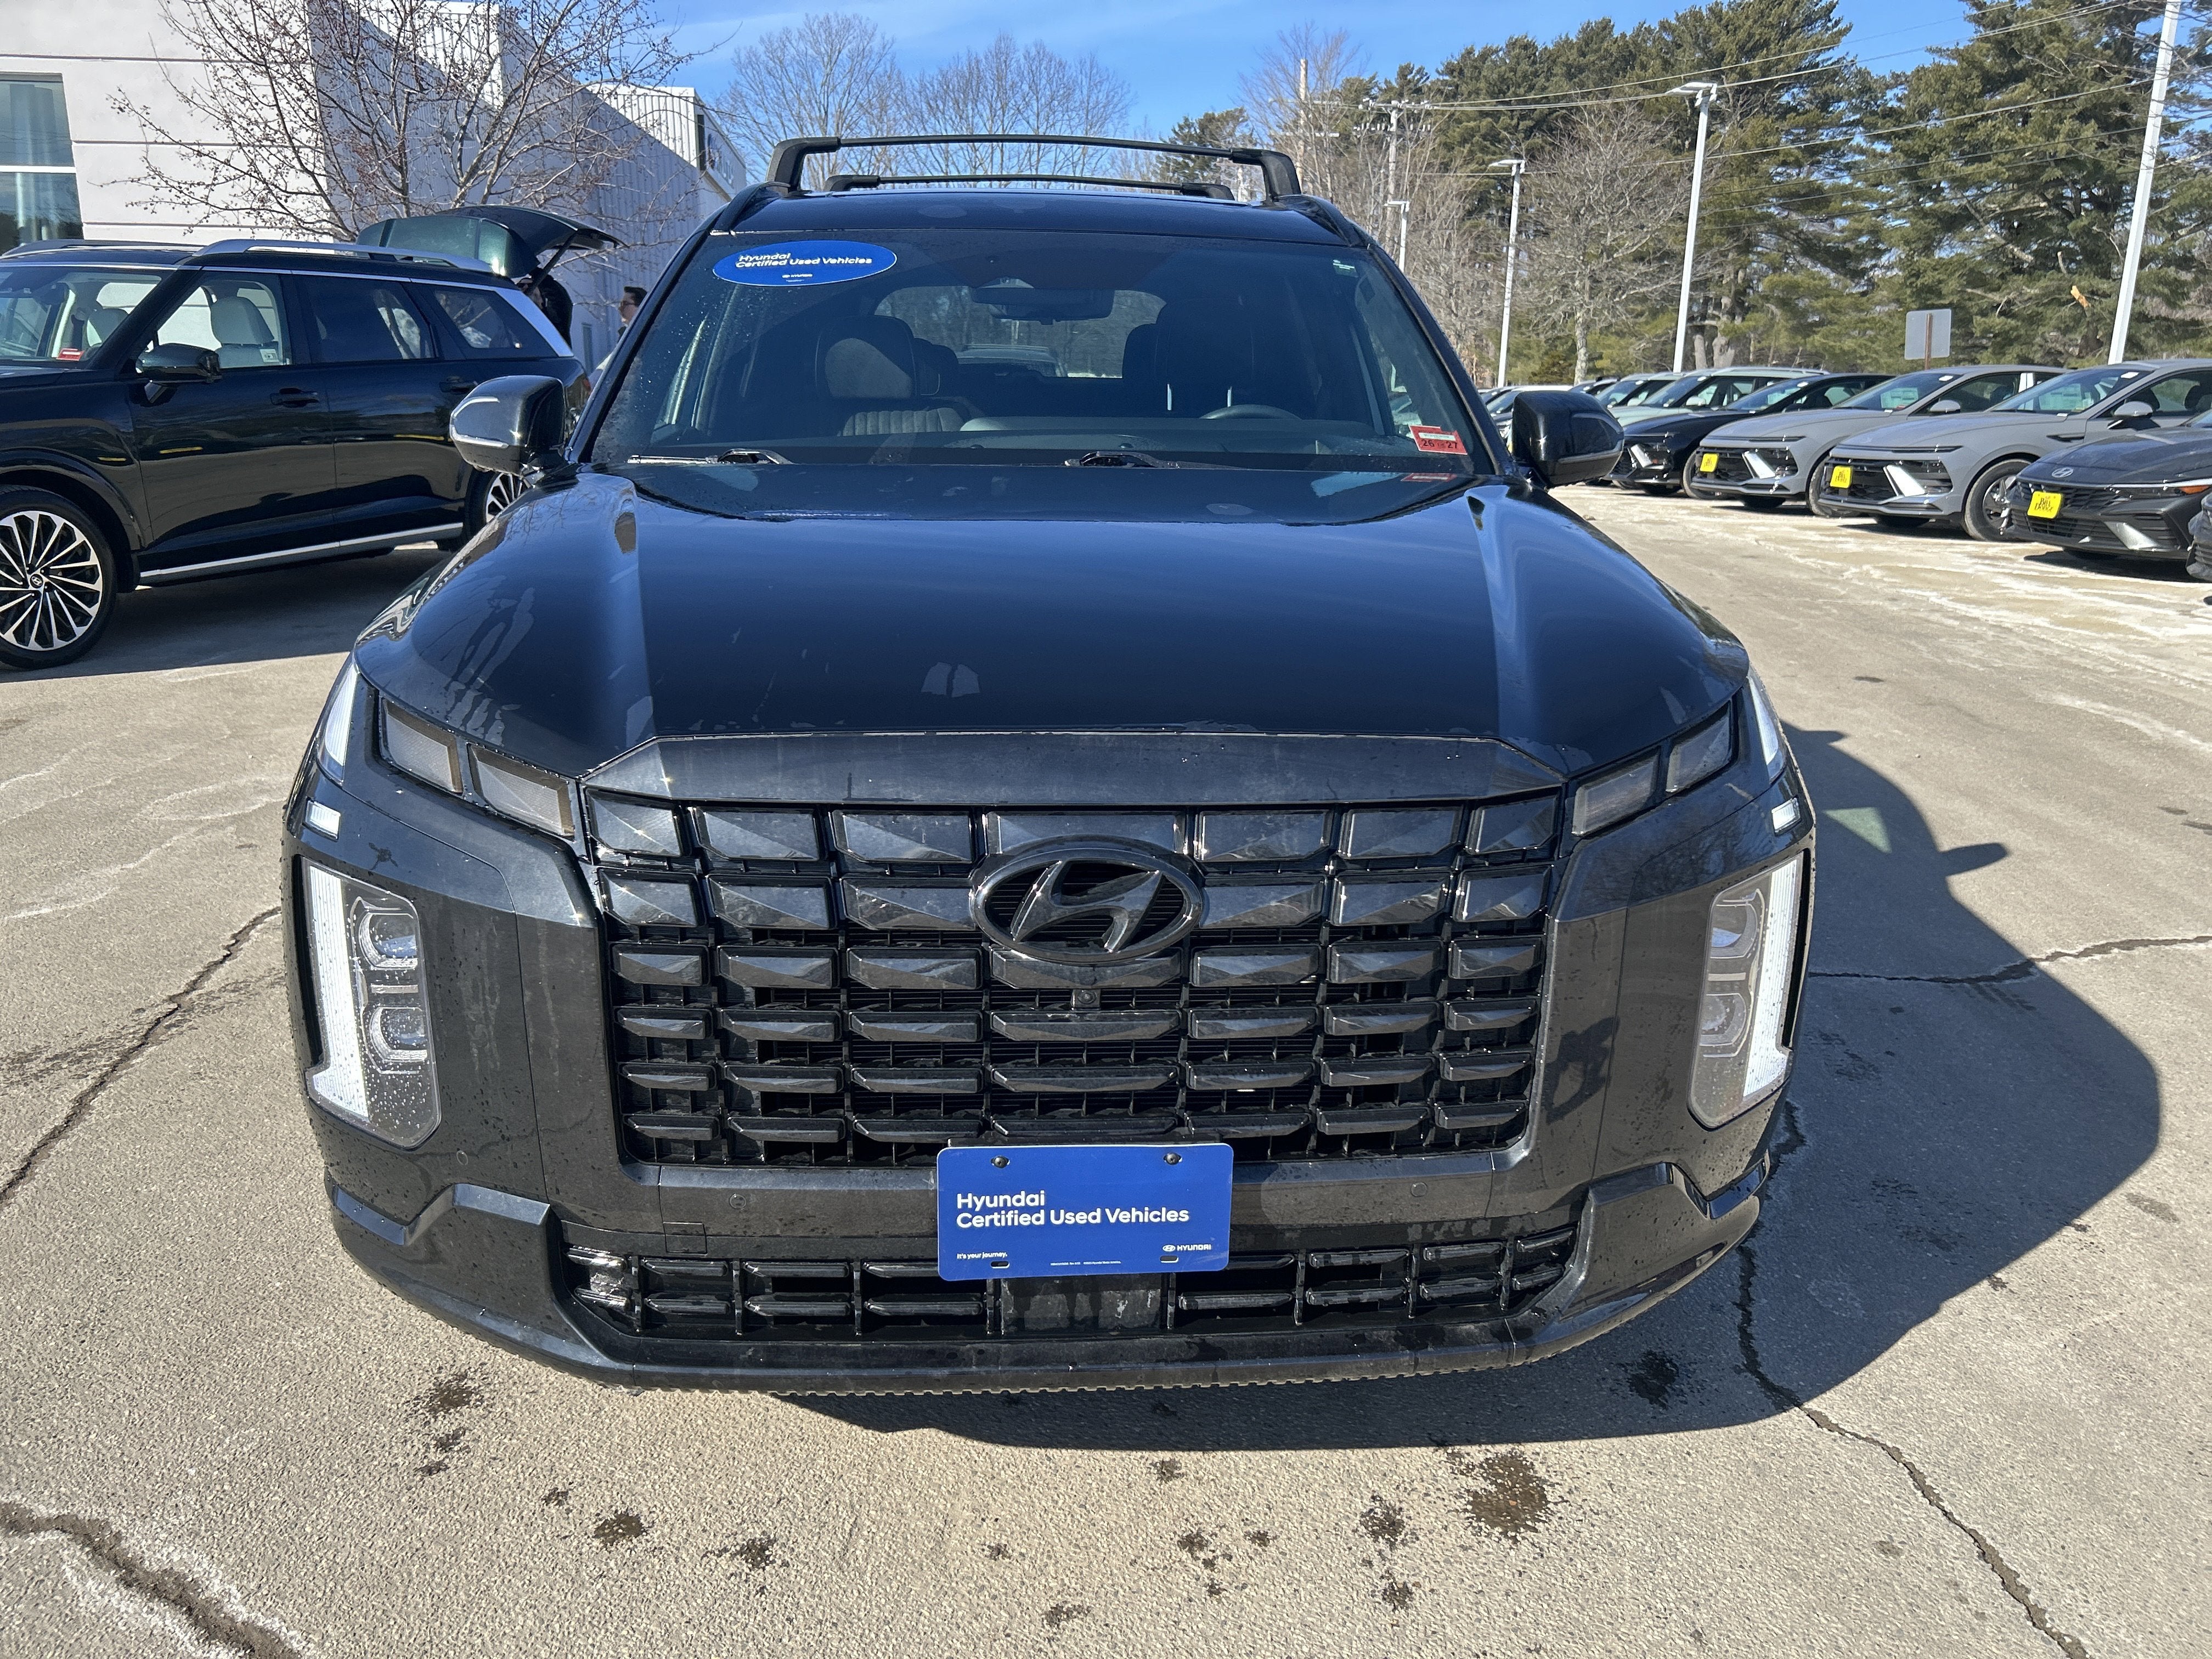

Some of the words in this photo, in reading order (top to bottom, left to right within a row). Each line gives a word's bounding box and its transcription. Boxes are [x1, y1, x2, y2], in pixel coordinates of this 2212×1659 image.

[738, 253, 791, 262] Hyundai
[735, 259, 788, 268] Certified
[1421, 439, 1435, 447] 26
[957, 1190, 1045, 1211] Hyundai
[956, 1209, 1045, 1228] Certified
[1050, 1207, 1101, 1224] Used
[1105, 1206, 1189, 1223] Vehicles
